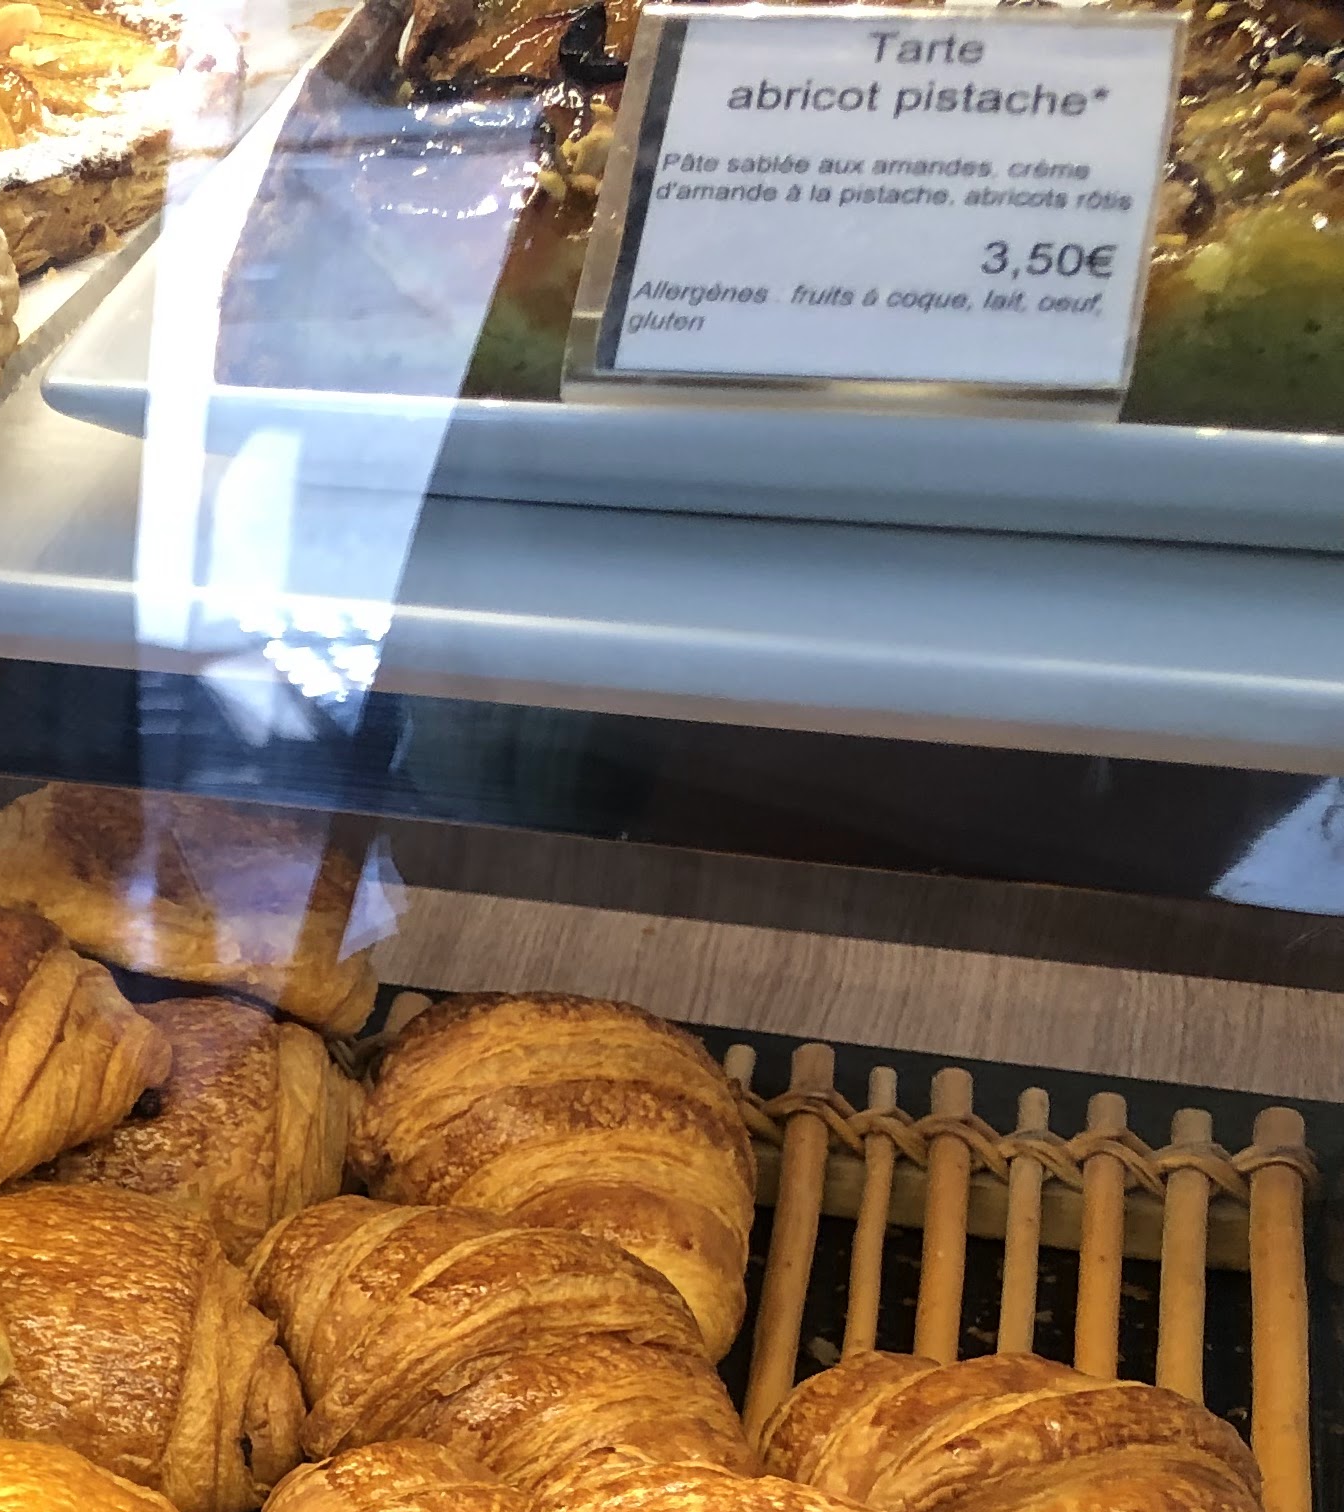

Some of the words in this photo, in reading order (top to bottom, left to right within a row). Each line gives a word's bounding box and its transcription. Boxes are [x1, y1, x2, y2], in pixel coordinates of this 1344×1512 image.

[869, 31, 984, 65] Tarte
[727, 79, 880, 112] abricot
[662, 152, 719, 172] Pâte
[728, 154, 810, 174] sablée
[818, 158, 865, 175] aux
[810, 185, 831, 202] la
[964, 186, 1068, 209] abricots
[981, 240, 1117, 281] 3,50€
[790, 284, 855, 306] fruits
[886, 290, 972, 313] coque,
[627, 310, 705, 334] gluten
